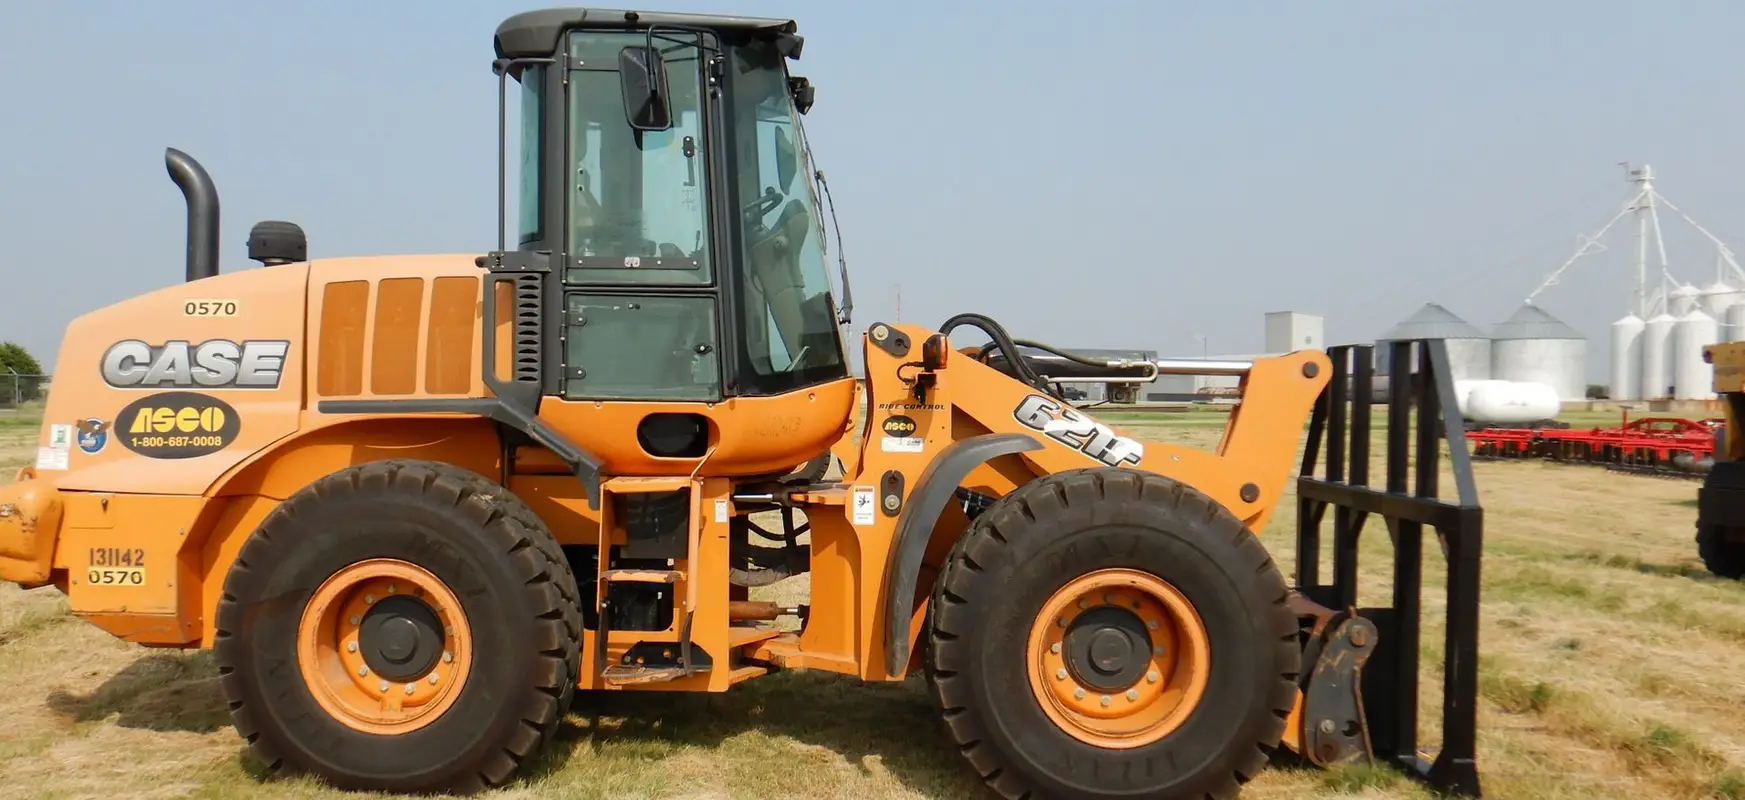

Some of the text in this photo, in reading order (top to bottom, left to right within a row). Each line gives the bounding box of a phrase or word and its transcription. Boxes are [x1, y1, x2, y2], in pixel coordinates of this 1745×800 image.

[185, 302, 236, 315] 0570
[101, 339, 290, 388] CASE
[129, 406, 225, 433] ASCO
[884, 421, 915, 431] ASCO
[131, 436, 222, 447] 1-800-687-0008
[89, 547, 144, 566] 131142
[88, 570, 143, 584] 0570
